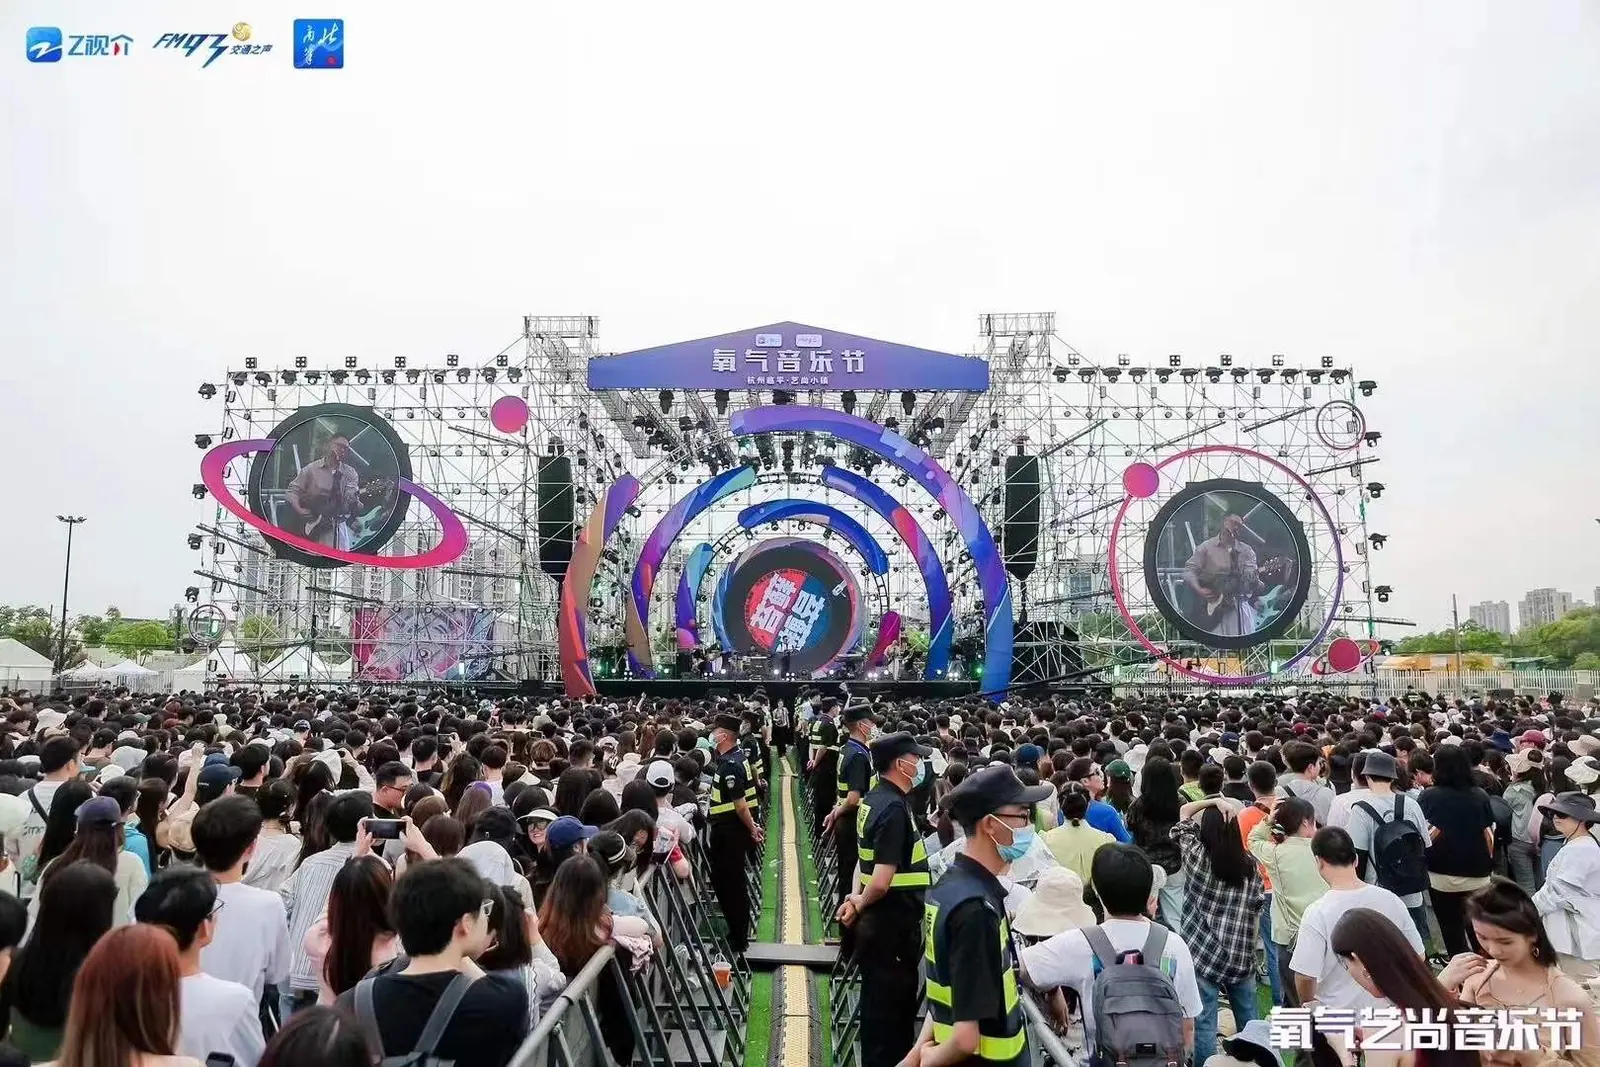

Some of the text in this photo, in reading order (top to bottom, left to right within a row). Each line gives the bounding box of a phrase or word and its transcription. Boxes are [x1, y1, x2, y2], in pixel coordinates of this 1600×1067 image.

[712, 348, 866, 373] 氧气音乐节
